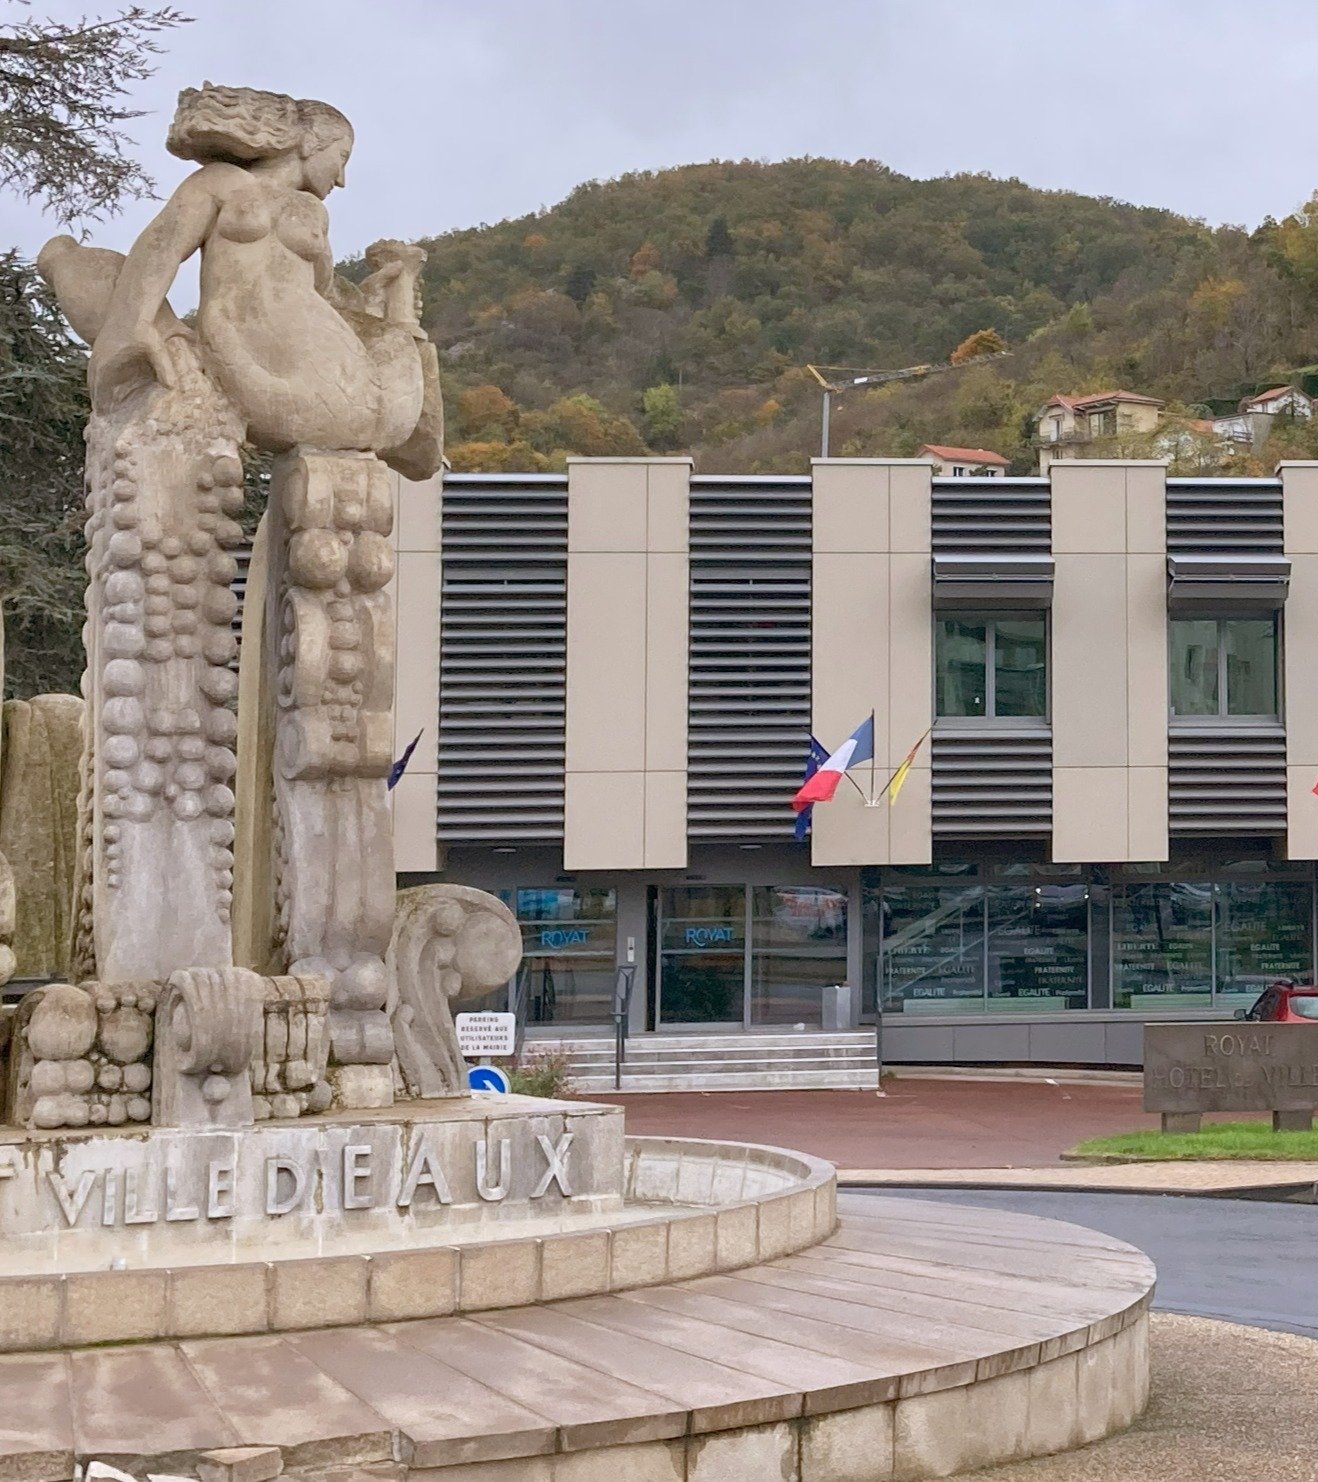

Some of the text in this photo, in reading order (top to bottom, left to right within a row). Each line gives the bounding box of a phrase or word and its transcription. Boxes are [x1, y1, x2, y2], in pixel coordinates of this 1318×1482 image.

[541, 928, 590, 949] ROYAT
[685, 926, 734, 947] ROYAT
[1203, 1034, 1273, 1056] ROYAT
[47, 1159, 237, 1227] VILLE
